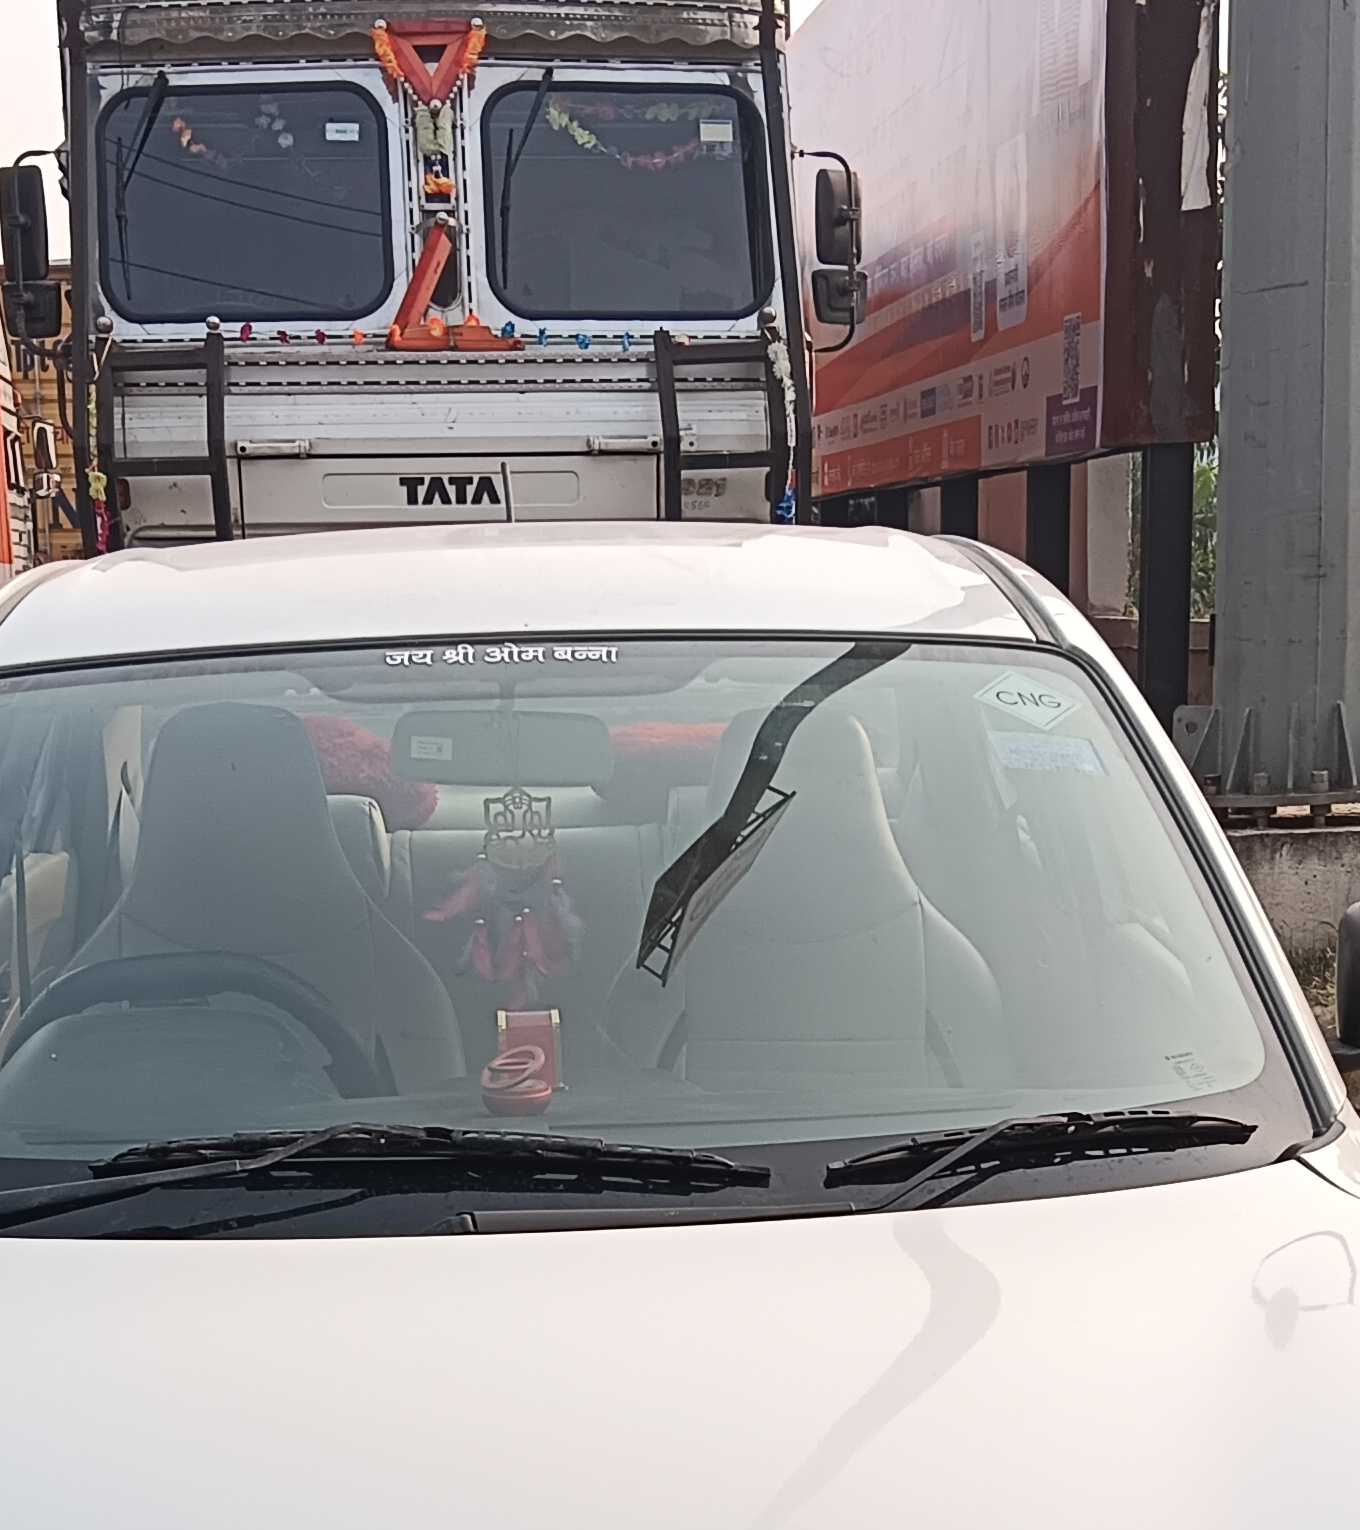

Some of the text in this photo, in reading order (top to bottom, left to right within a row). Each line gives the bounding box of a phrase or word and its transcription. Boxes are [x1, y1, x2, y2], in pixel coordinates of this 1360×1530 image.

[399, 476, 501, 505] TATA
[385, 642, 618, 666] जय श्री ओम बन्ना
[996, 690, 1062, 709] CNG
